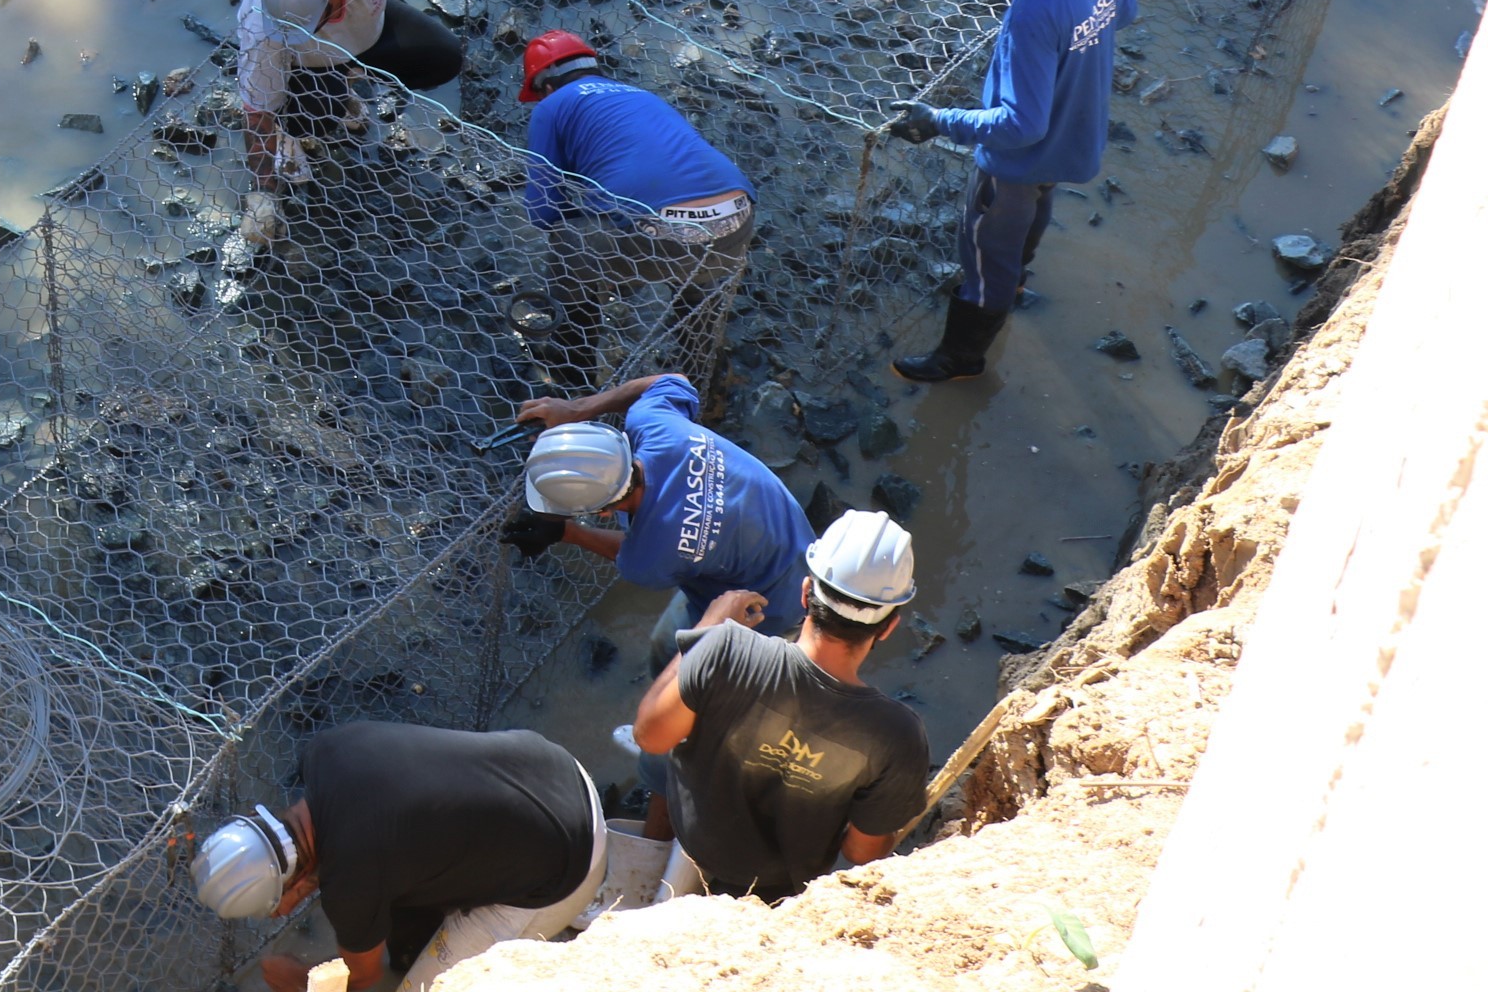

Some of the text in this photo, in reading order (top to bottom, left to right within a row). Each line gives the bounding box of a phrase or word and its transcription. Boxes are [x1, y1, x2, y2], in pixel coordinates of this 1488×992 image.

[665, 209, 720, 219] PITBULL
[677, 433, 707, 554] PENASCAL
[712, 450, 725, 535] 11 3044.3043
[698, 510, 713, 556] ENGENHARIA
